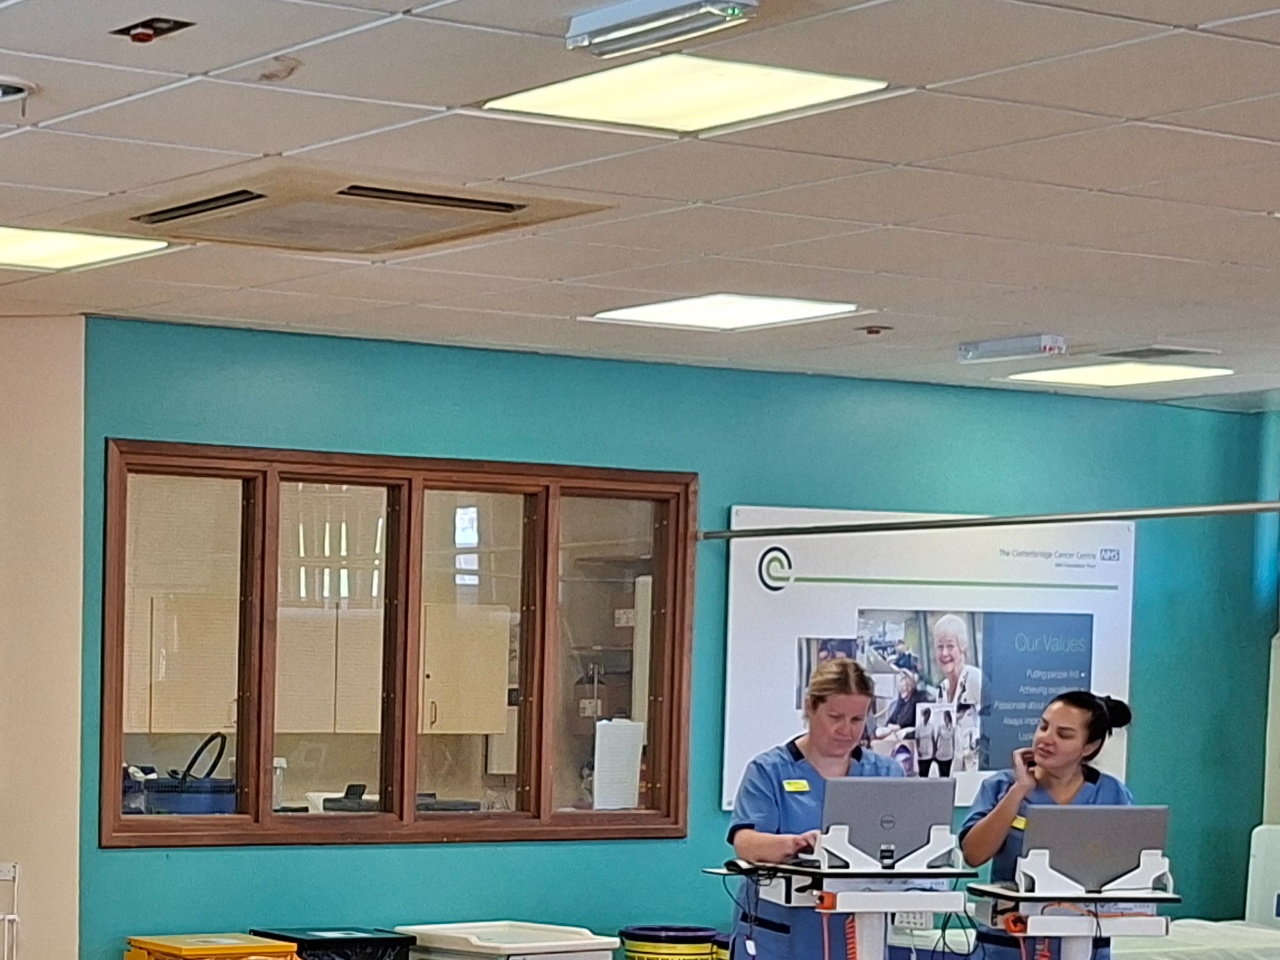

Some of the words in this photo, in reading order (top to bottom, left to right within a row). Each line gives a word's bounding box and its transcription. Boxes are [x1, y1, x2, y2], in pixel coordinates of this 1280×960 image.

[1053, 550, 1075, 559] Cancer
[1101, 550, 1119, 560] NHS
[1014, 633, 1040, 652] Our
[1042, 633, 1086, 652] Values
